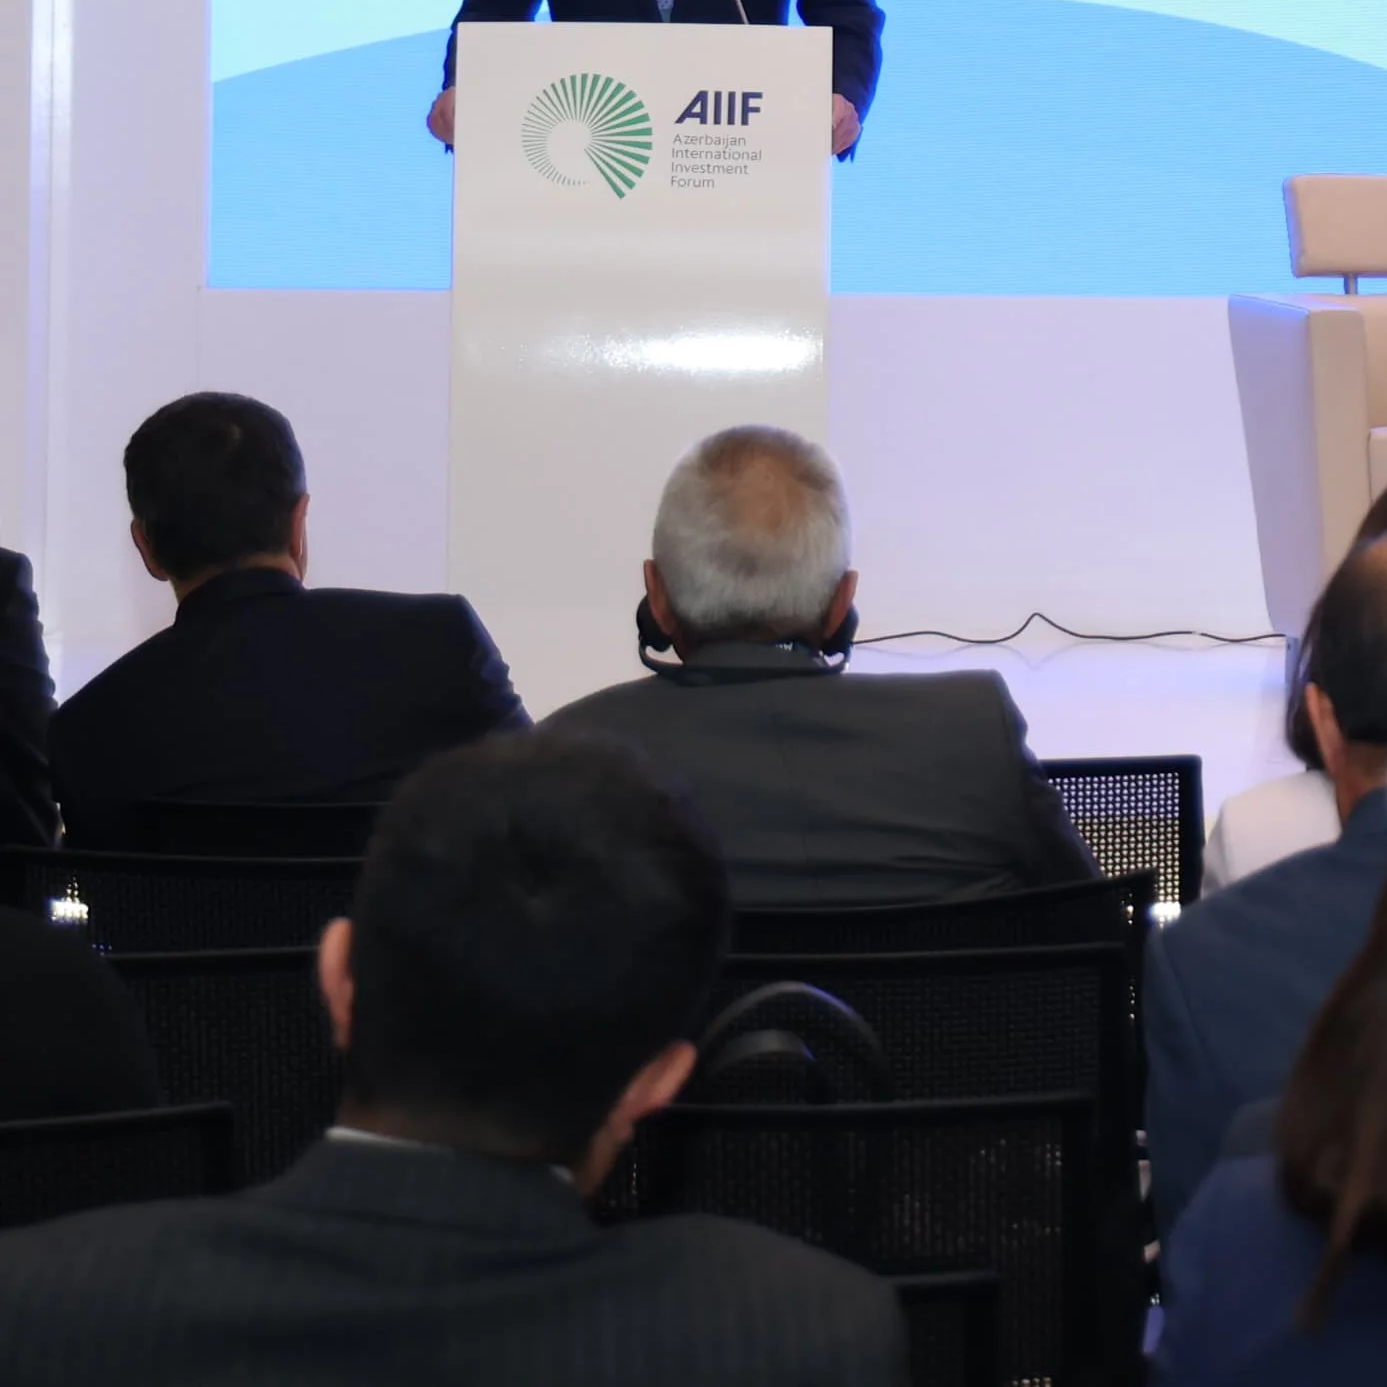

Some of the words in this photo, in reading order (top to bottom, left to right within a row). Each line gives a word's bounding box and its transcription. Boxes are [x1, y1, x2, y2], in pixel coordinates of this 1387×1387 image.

[674, 89, 764, 126] AIIF
[672, 133, 747, 149] Azerbaijan
[671, 148, 762, 161] International
[671, 161, 749, 175] Investment
[670, 175, 715, 188] Forum
